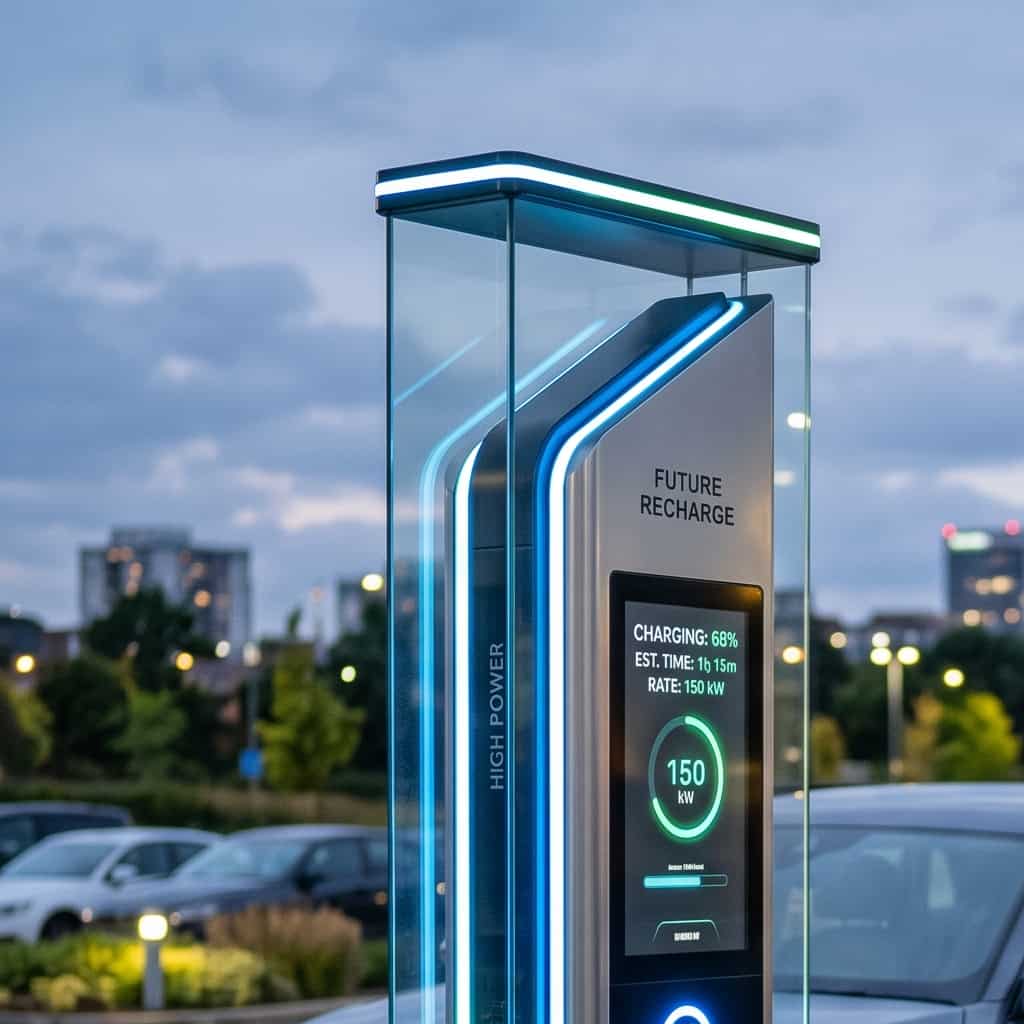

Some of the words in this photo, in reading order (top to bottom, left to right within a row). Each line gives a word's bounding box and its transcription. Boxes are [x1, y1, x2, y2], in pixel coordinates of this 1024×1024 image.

[655, 468, 722, 496] FUTURE
[640, 494, 735, 526] RECHARGE
[633, 623, 708, 646] CHARGING:
[711, 630, 738, 648] 68%
[635, 651, 660, 668] EST.
[662, 653, 694, 671] TIME:
[714, 657, 737, 673] 15m
[489, 643, 504, 726] POWER
[648, 676, 682, 694] RATE:
[684, 679, 705, 695] 150
[707, 681, 725, 696] kW
[490, 735, 504, 790] HIGH
[667, 759, 705, 786] 150
[678, 789, 695, 805] kW
